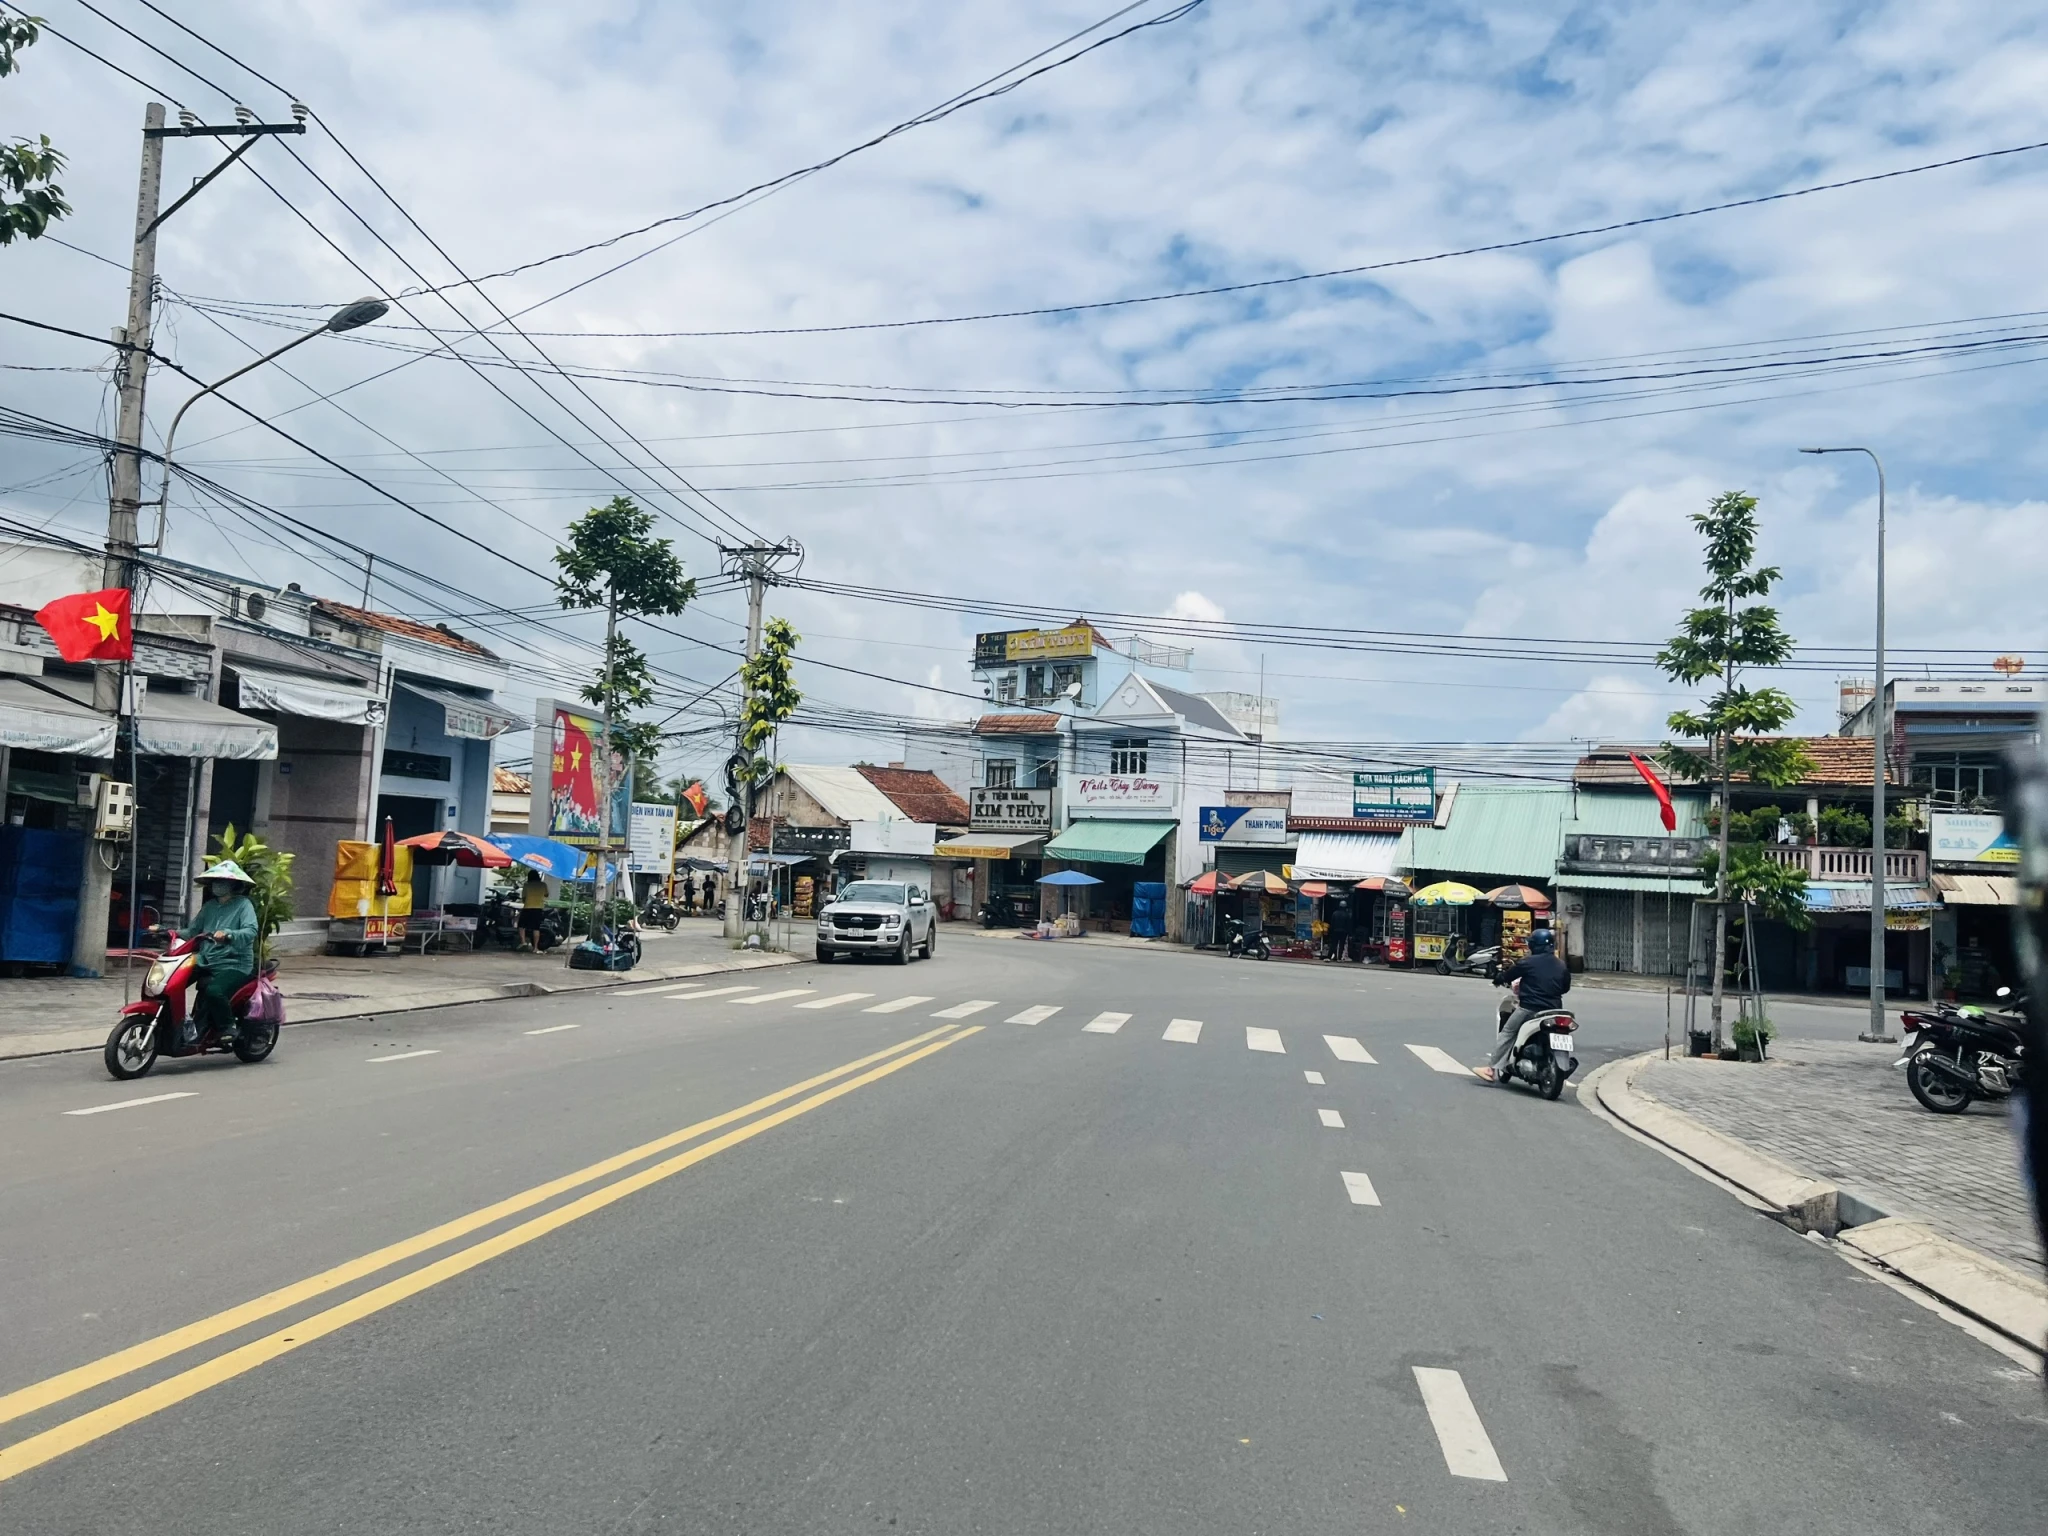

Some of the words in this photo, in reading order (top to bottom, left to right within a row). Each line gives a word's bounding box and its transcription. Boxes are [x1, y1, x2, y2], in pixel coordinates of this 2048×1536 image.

[975, 803, 1002, 817] KIM
[1202, 824, 1226, 836] Tiger
[1245, 820, 1264, 828] THANH
[1265, 820, 1284, 829] PHONG
